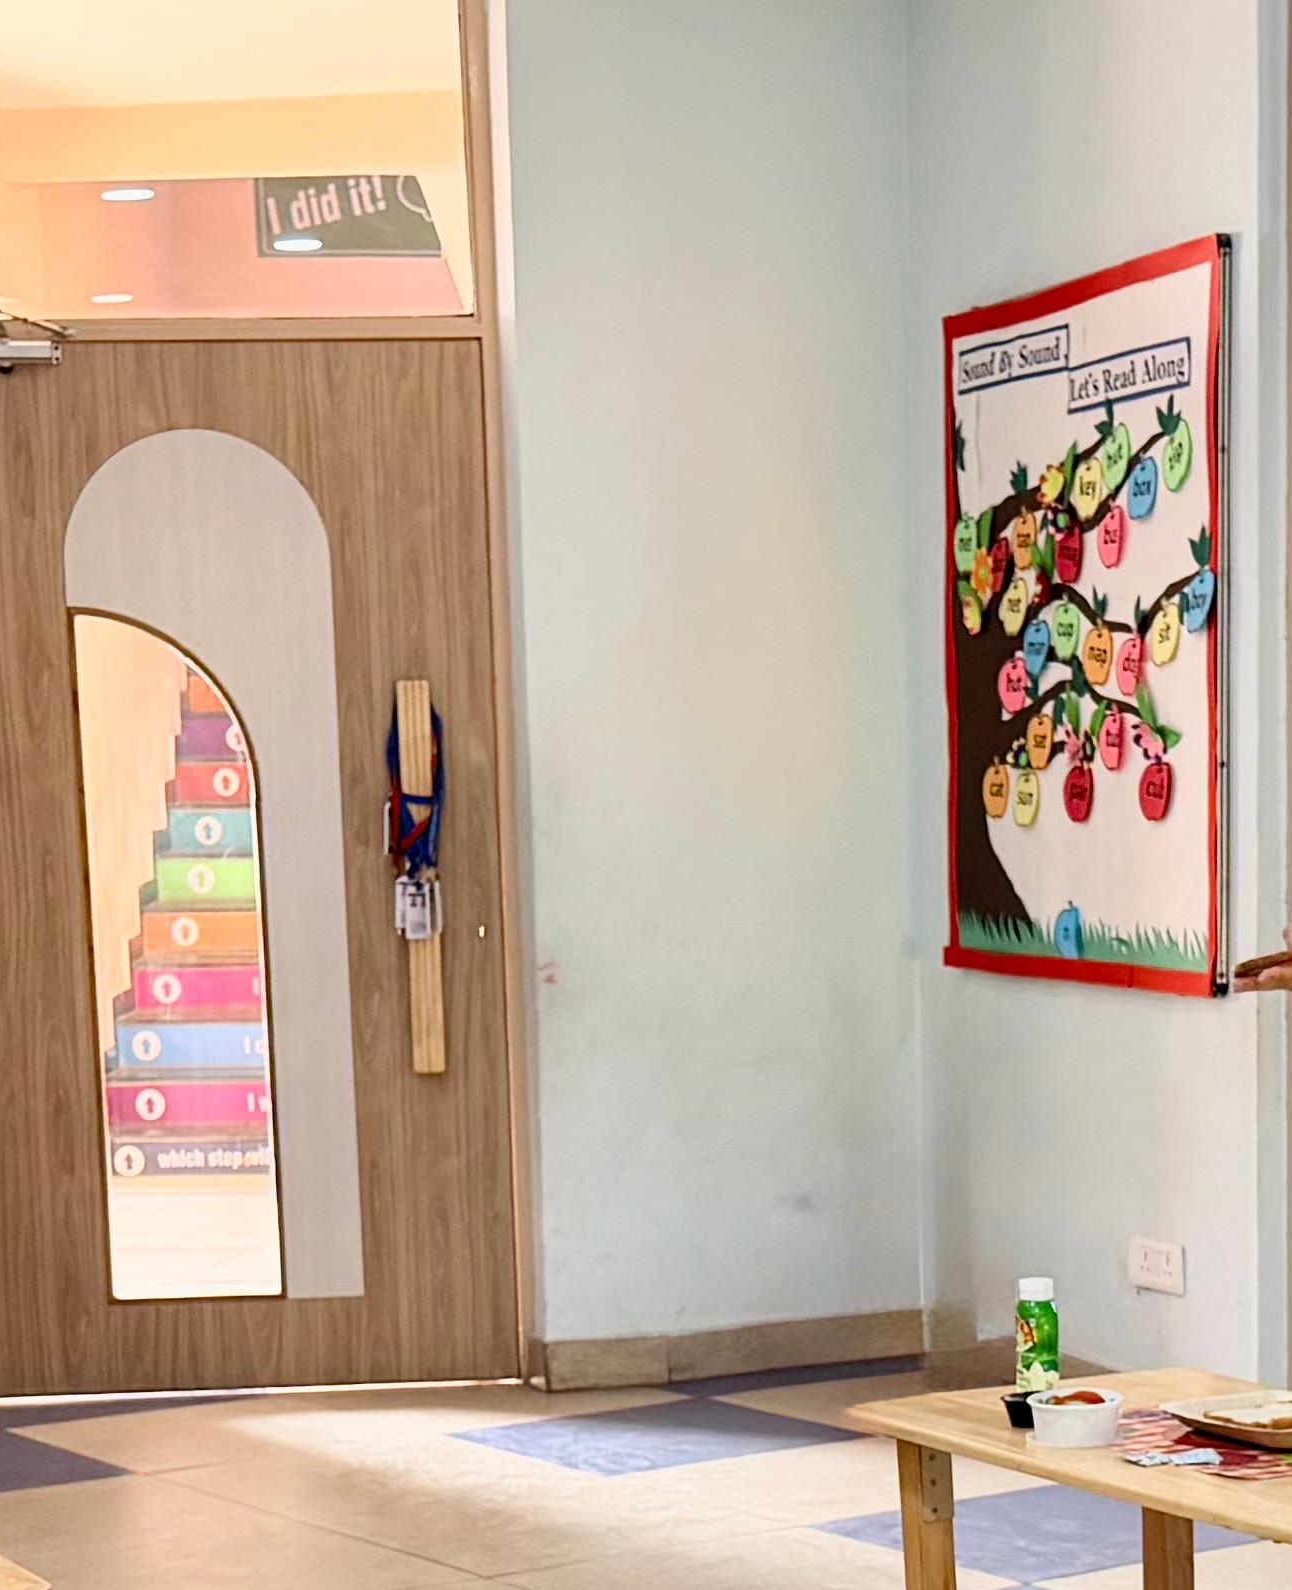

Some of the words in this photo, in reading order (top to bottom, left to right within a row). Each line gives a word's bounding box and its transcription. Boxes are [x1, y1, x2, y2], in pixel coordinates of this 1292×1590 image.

[267, 197, 281, 235] I
[290, 183, 342, 230] did
[347, 175, 387, 216] it!
[961, 352, 996, 384] Sound
[999, 349, 1013, 378] By
[1069, 372, 1101, 402] Let's
[1103, 364, 1137, 395] Read
[1142, 353, 1186, 385] Along
